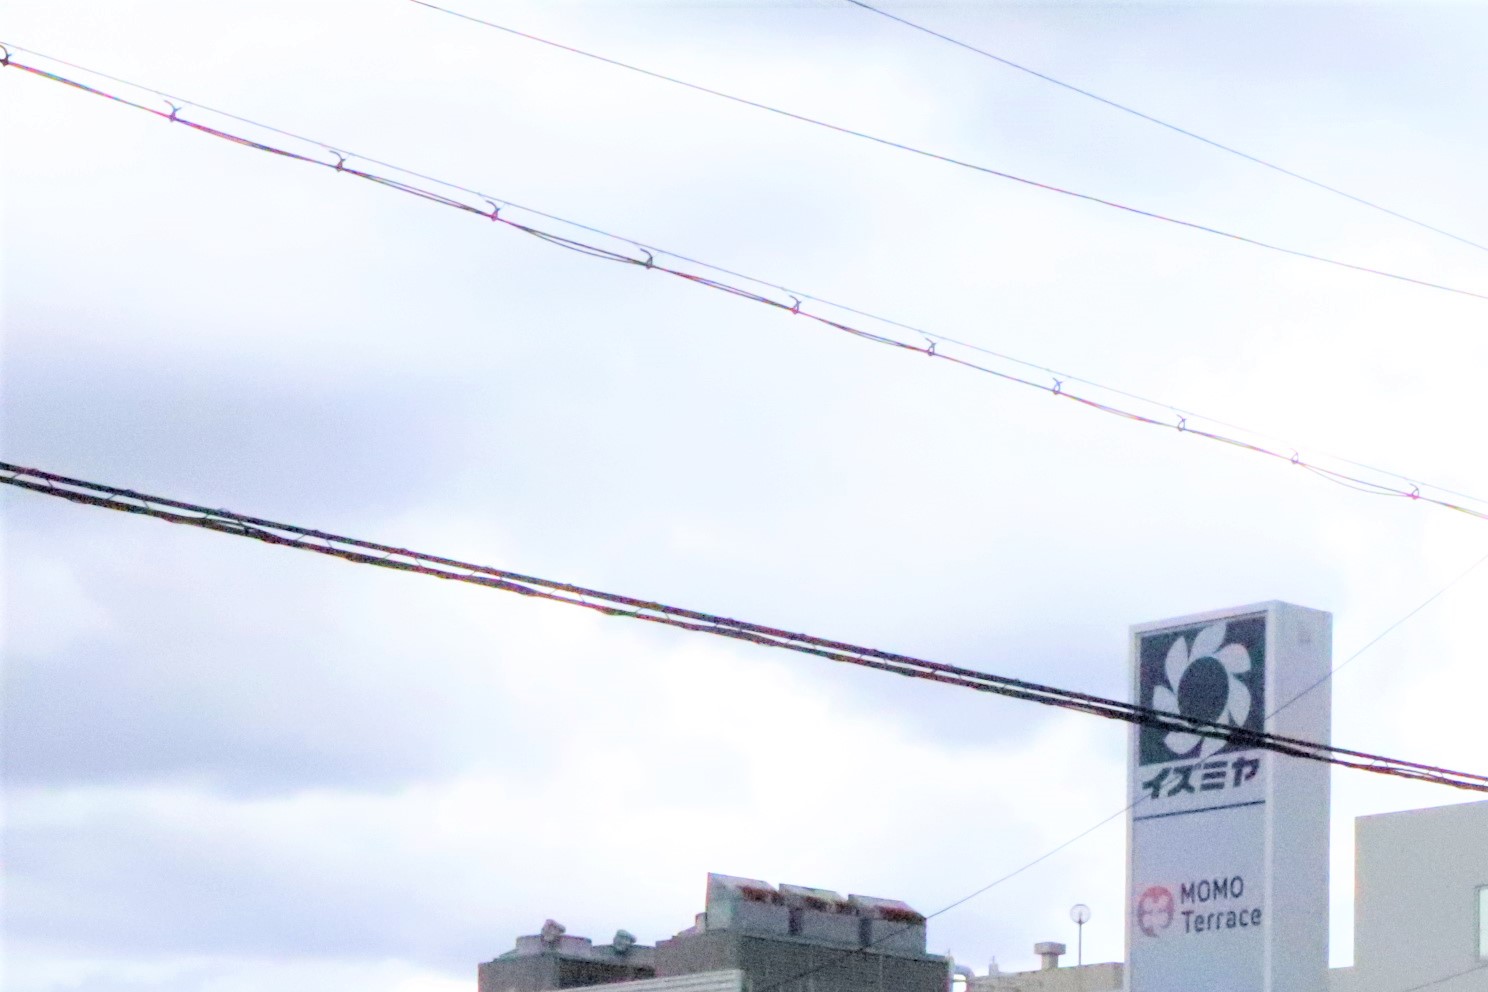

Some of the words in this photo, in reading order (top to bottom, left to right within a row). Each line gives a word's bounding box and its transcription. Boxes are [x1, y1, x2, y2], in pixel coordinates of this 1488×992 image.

[1141, 757, 1260, 800] イズミヤ
[1180, 875, 1244, 902] MOMO
[1181, 906, 1262, 933] Terrace
